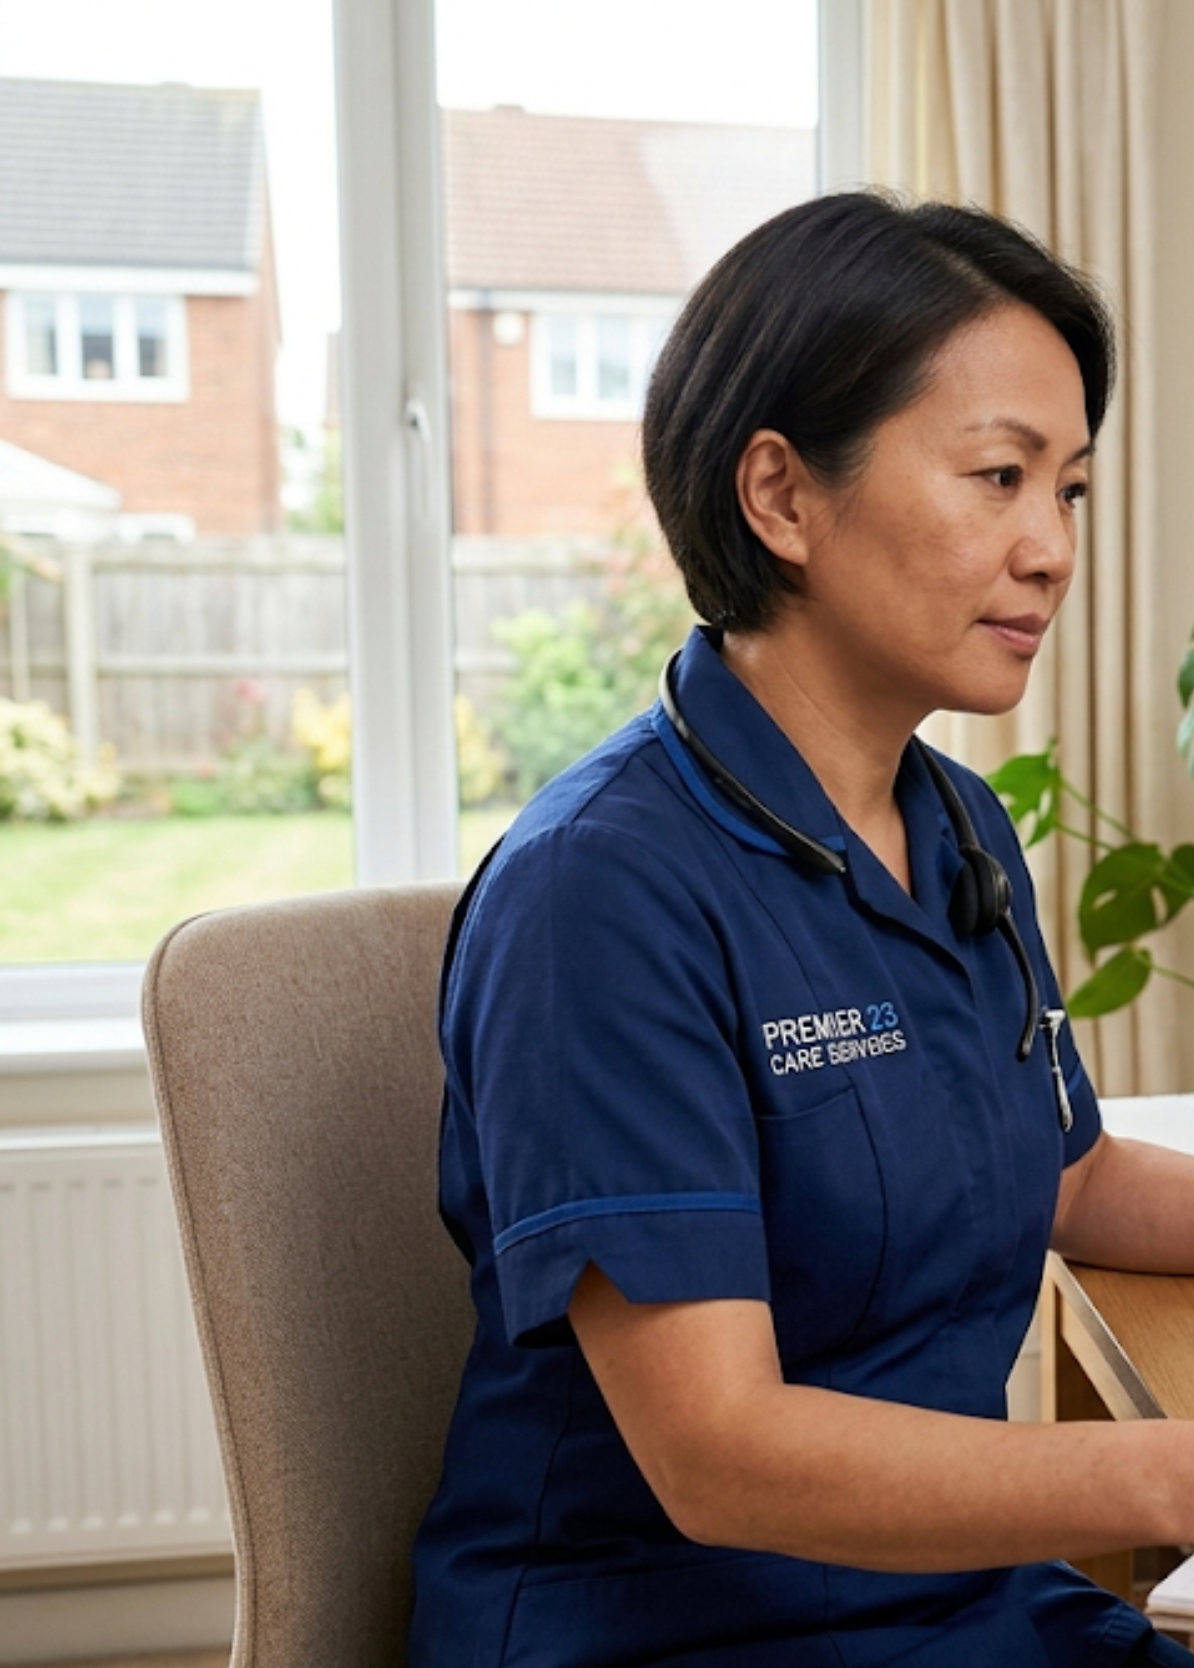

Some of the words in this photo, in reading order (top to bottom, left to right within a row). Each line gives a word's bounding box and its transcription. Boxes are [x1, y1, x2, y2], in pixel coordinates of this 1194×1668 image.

[762, 1008, 866, 1050] PREMIER
[867, 1002, 898, 1031] 23
[770, 1046, 824, 1075] CARE
